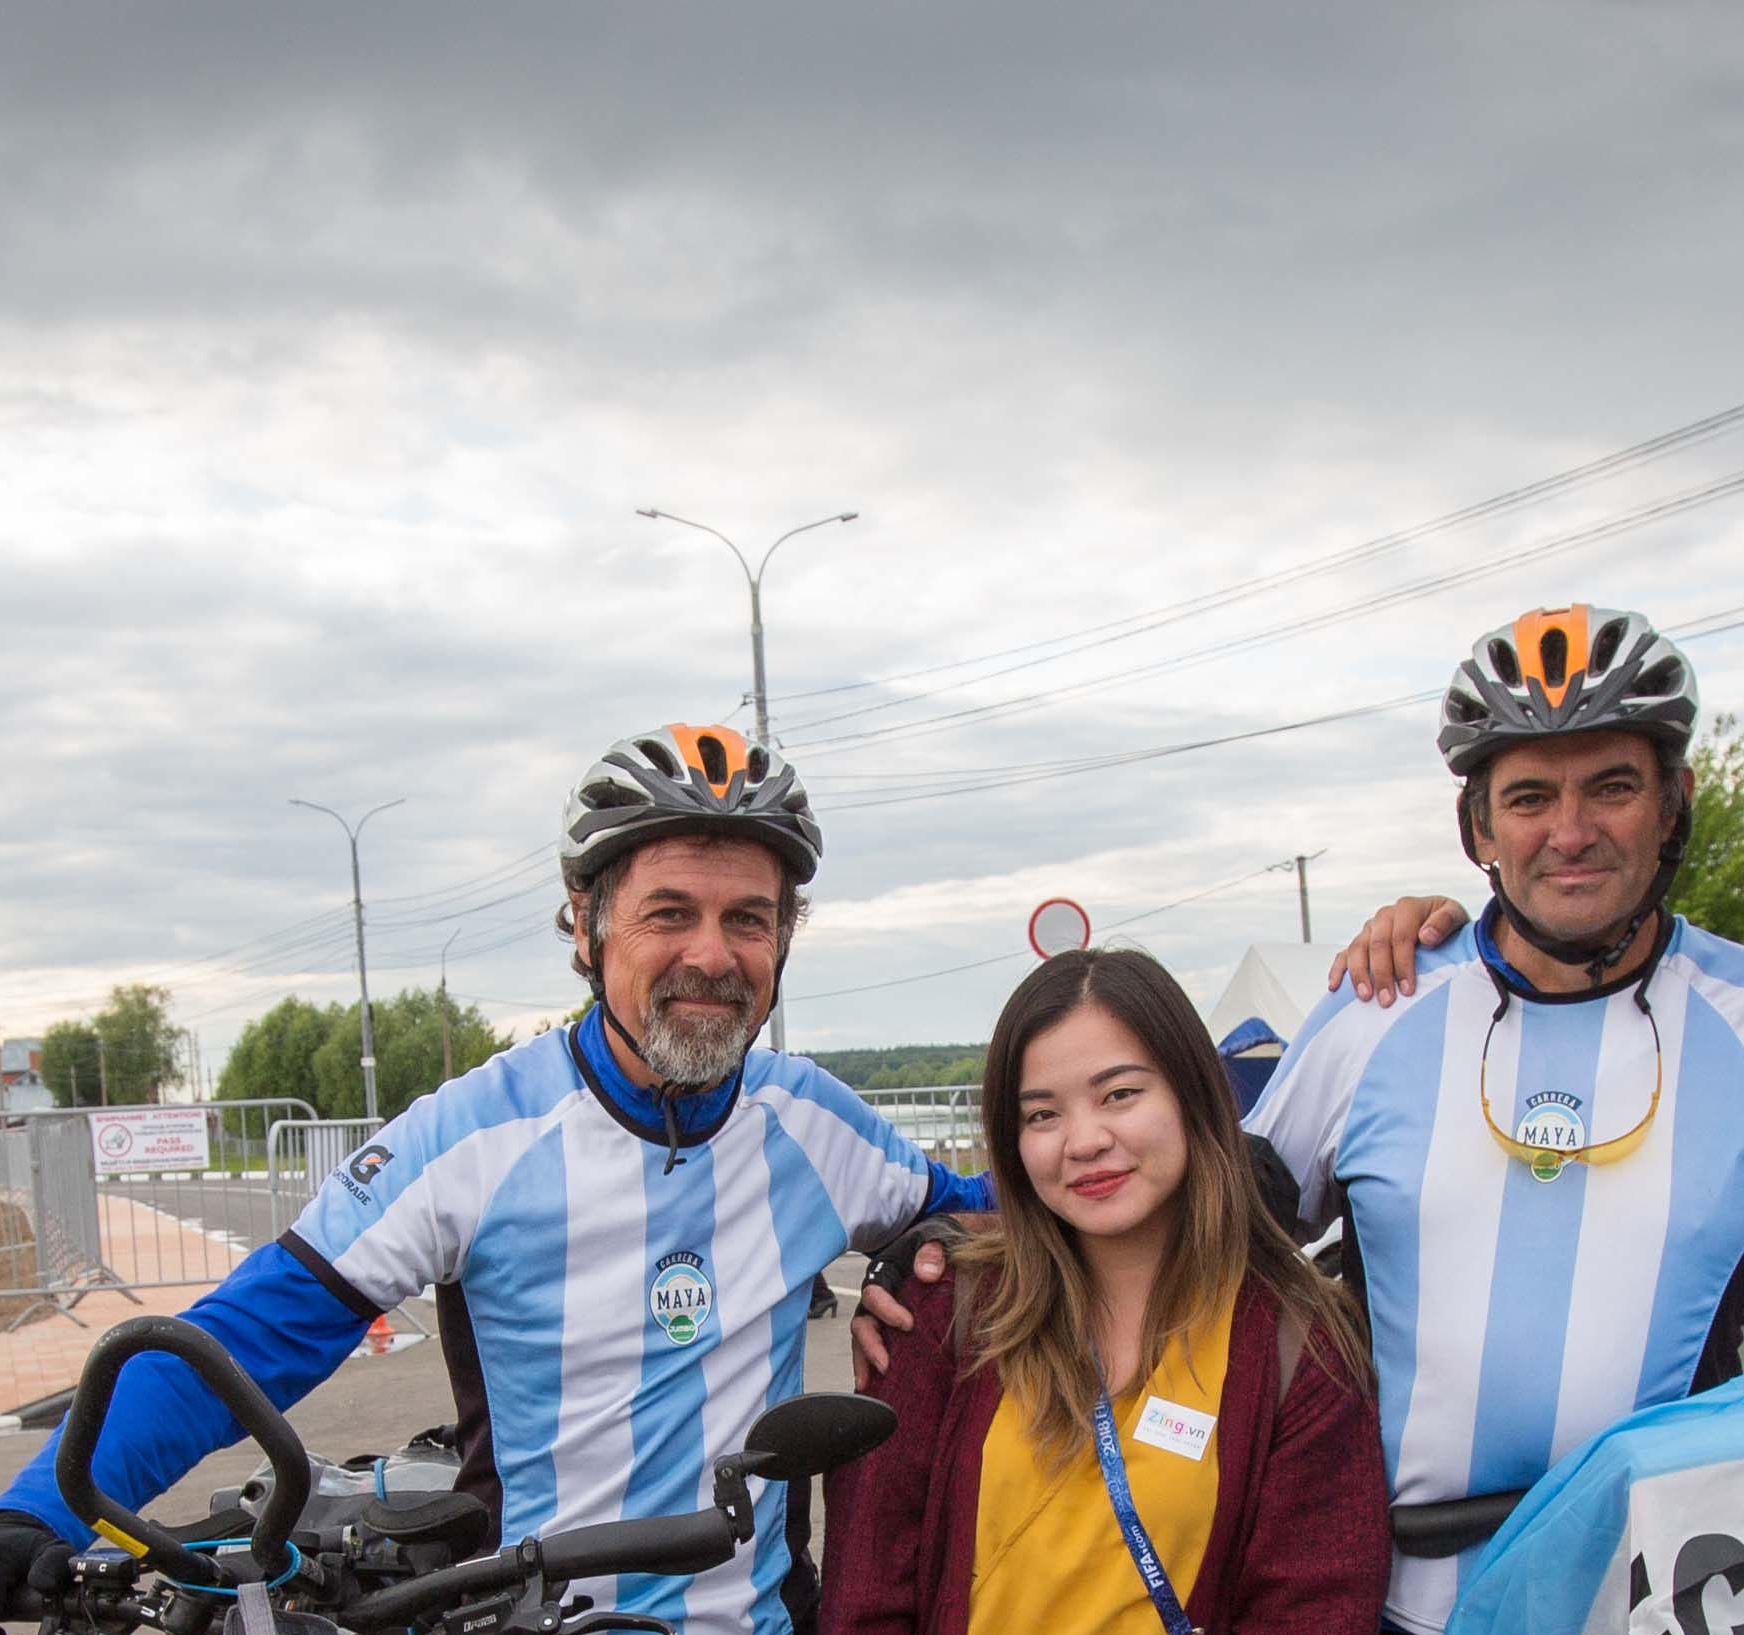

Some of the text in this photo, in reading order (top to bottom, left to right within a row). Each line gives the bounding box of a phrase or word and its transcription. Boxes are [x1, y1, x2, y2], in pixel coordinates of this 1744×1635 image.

[1530, 1092, 1577, 1108] CARRERA
[157, 1137, 181, 1145] PASS
[1523, 1126, 1577, 1146] MAYA
[144, 1145, 195, 1155] REQUIRED
[659, 1252, 699, 1269] CARRERA
[657, 1287, 706, 1310] MAYA
[1149, 1409, 1206, 1439] Zing.vn
[1096, 1420, 1117, 1456] 2018
